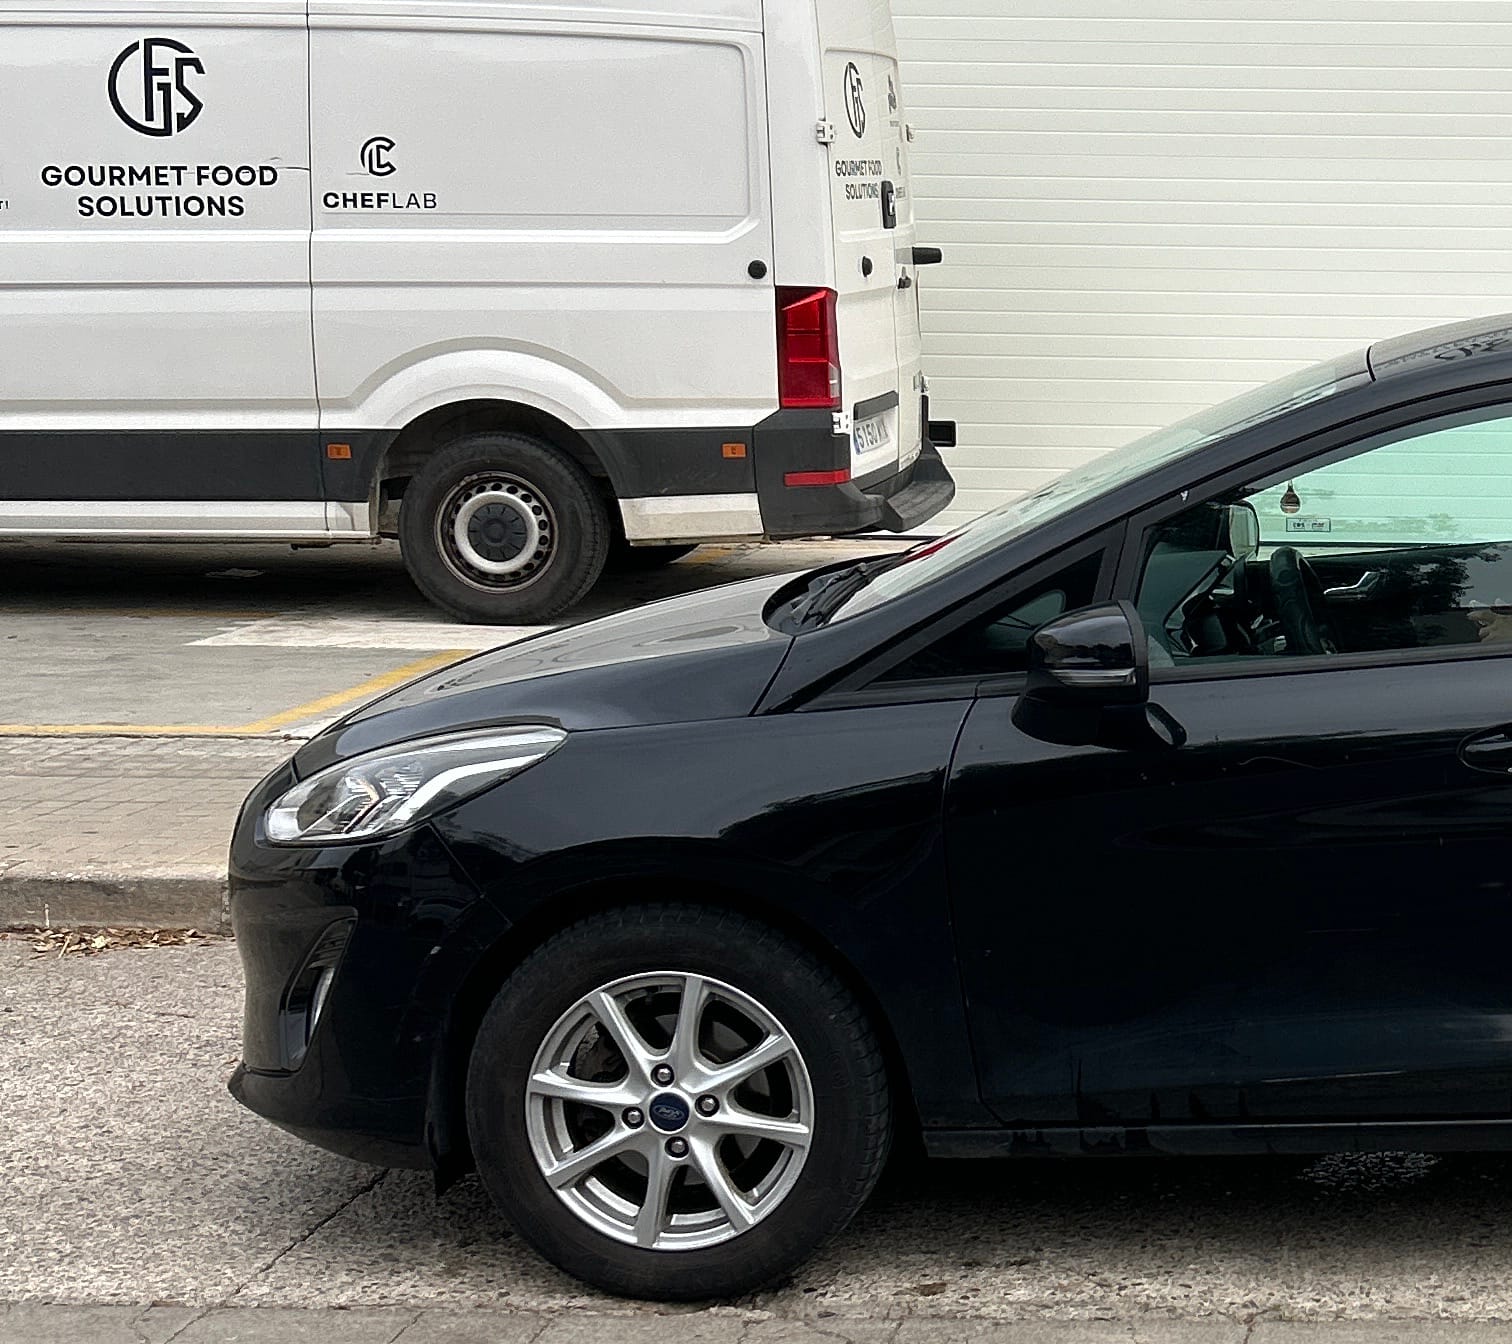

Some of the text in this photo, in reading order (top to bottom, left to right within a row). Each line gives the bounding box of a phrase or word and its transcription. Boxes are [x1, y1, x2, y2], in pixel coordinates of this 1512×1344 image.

[41, 164, 279, 188] GOURMET FOOD
[836, 159, 867, 177] GOURMET
[77, 195, 245, 217] SOLUTIONS
[322, 192, 438, 210] CHEFLAB
